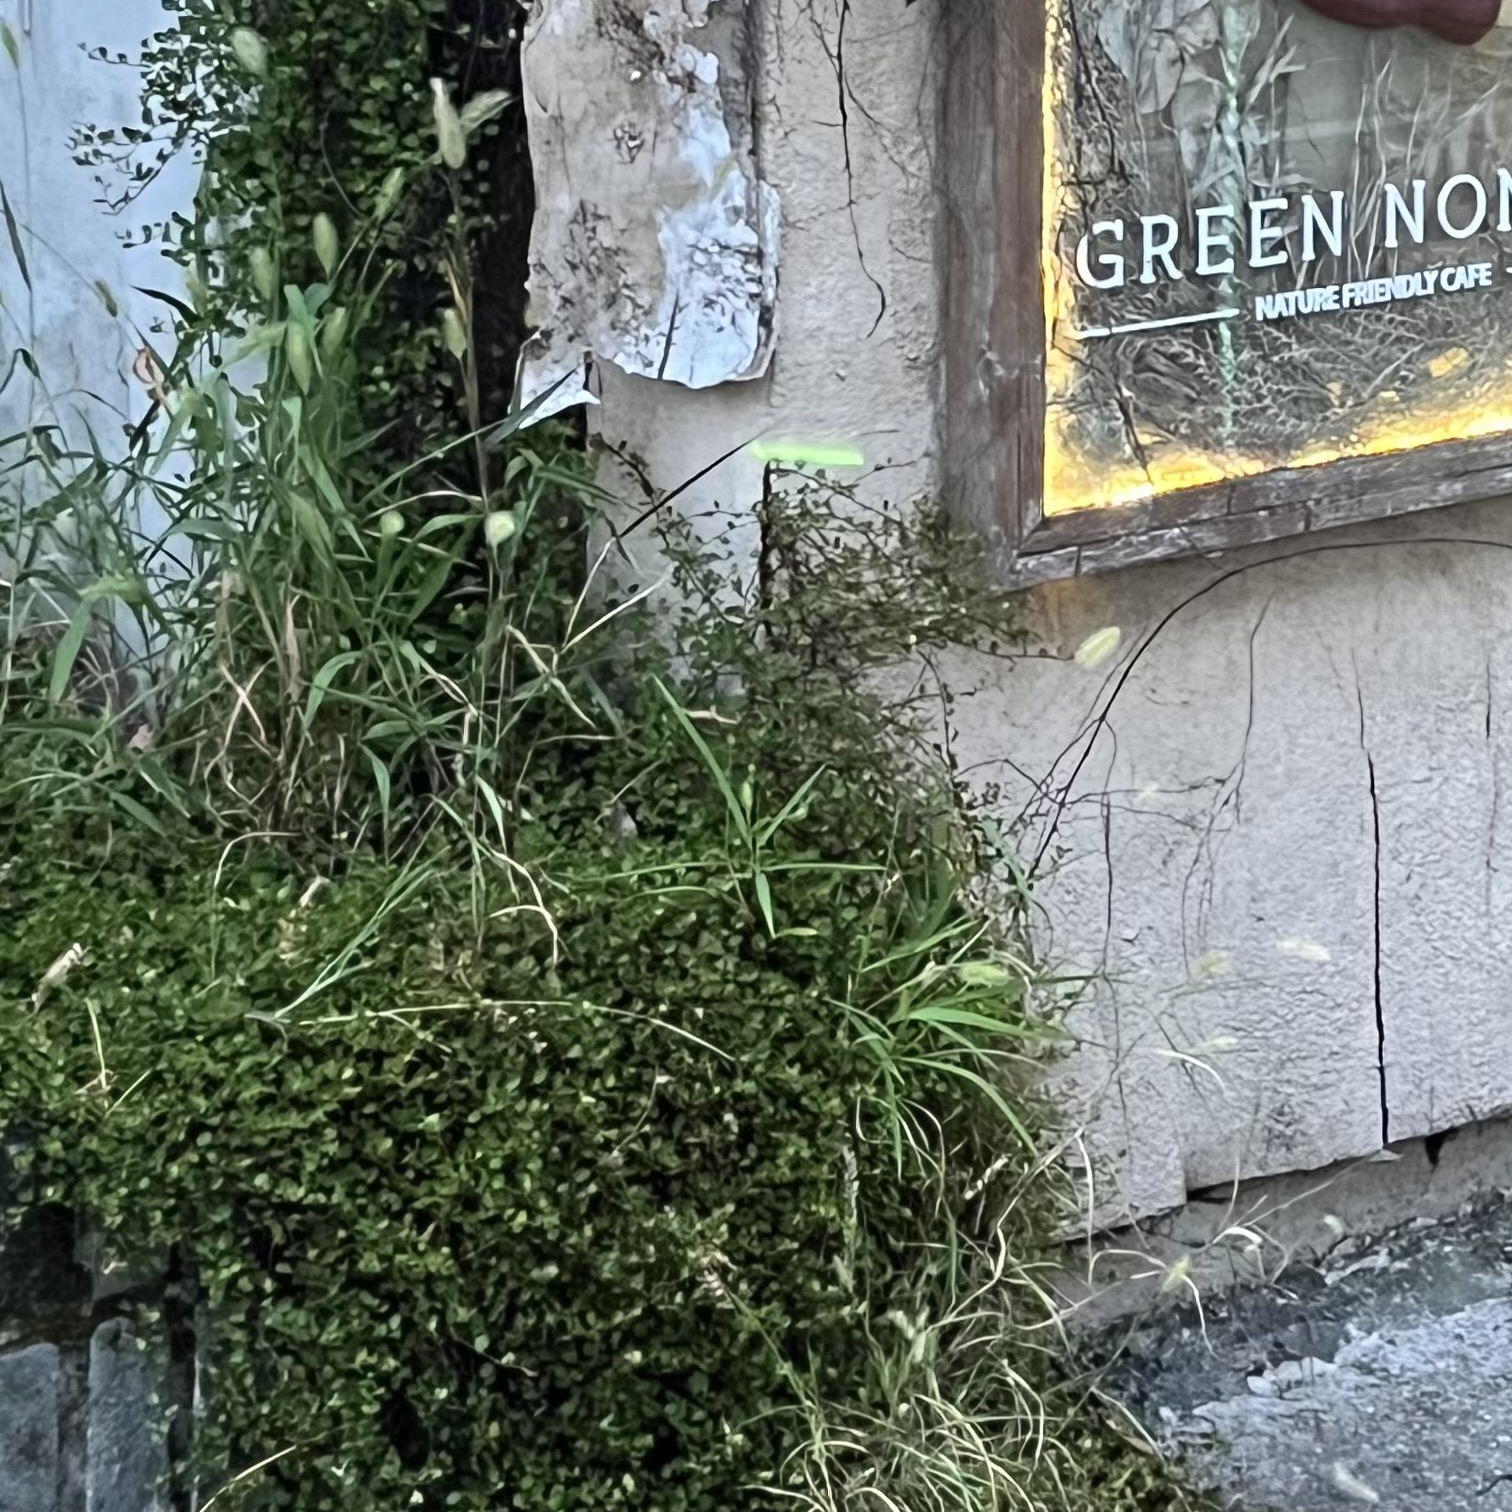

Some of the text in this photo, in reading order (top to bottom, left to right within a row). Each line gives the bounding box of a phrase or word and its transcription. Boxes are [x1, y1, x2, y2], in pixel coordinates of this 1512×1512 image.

[1075, 190, 1345, 289] GREEN
[1255, 262, 1493, 321] NATURE FRIENDLY CAFE
